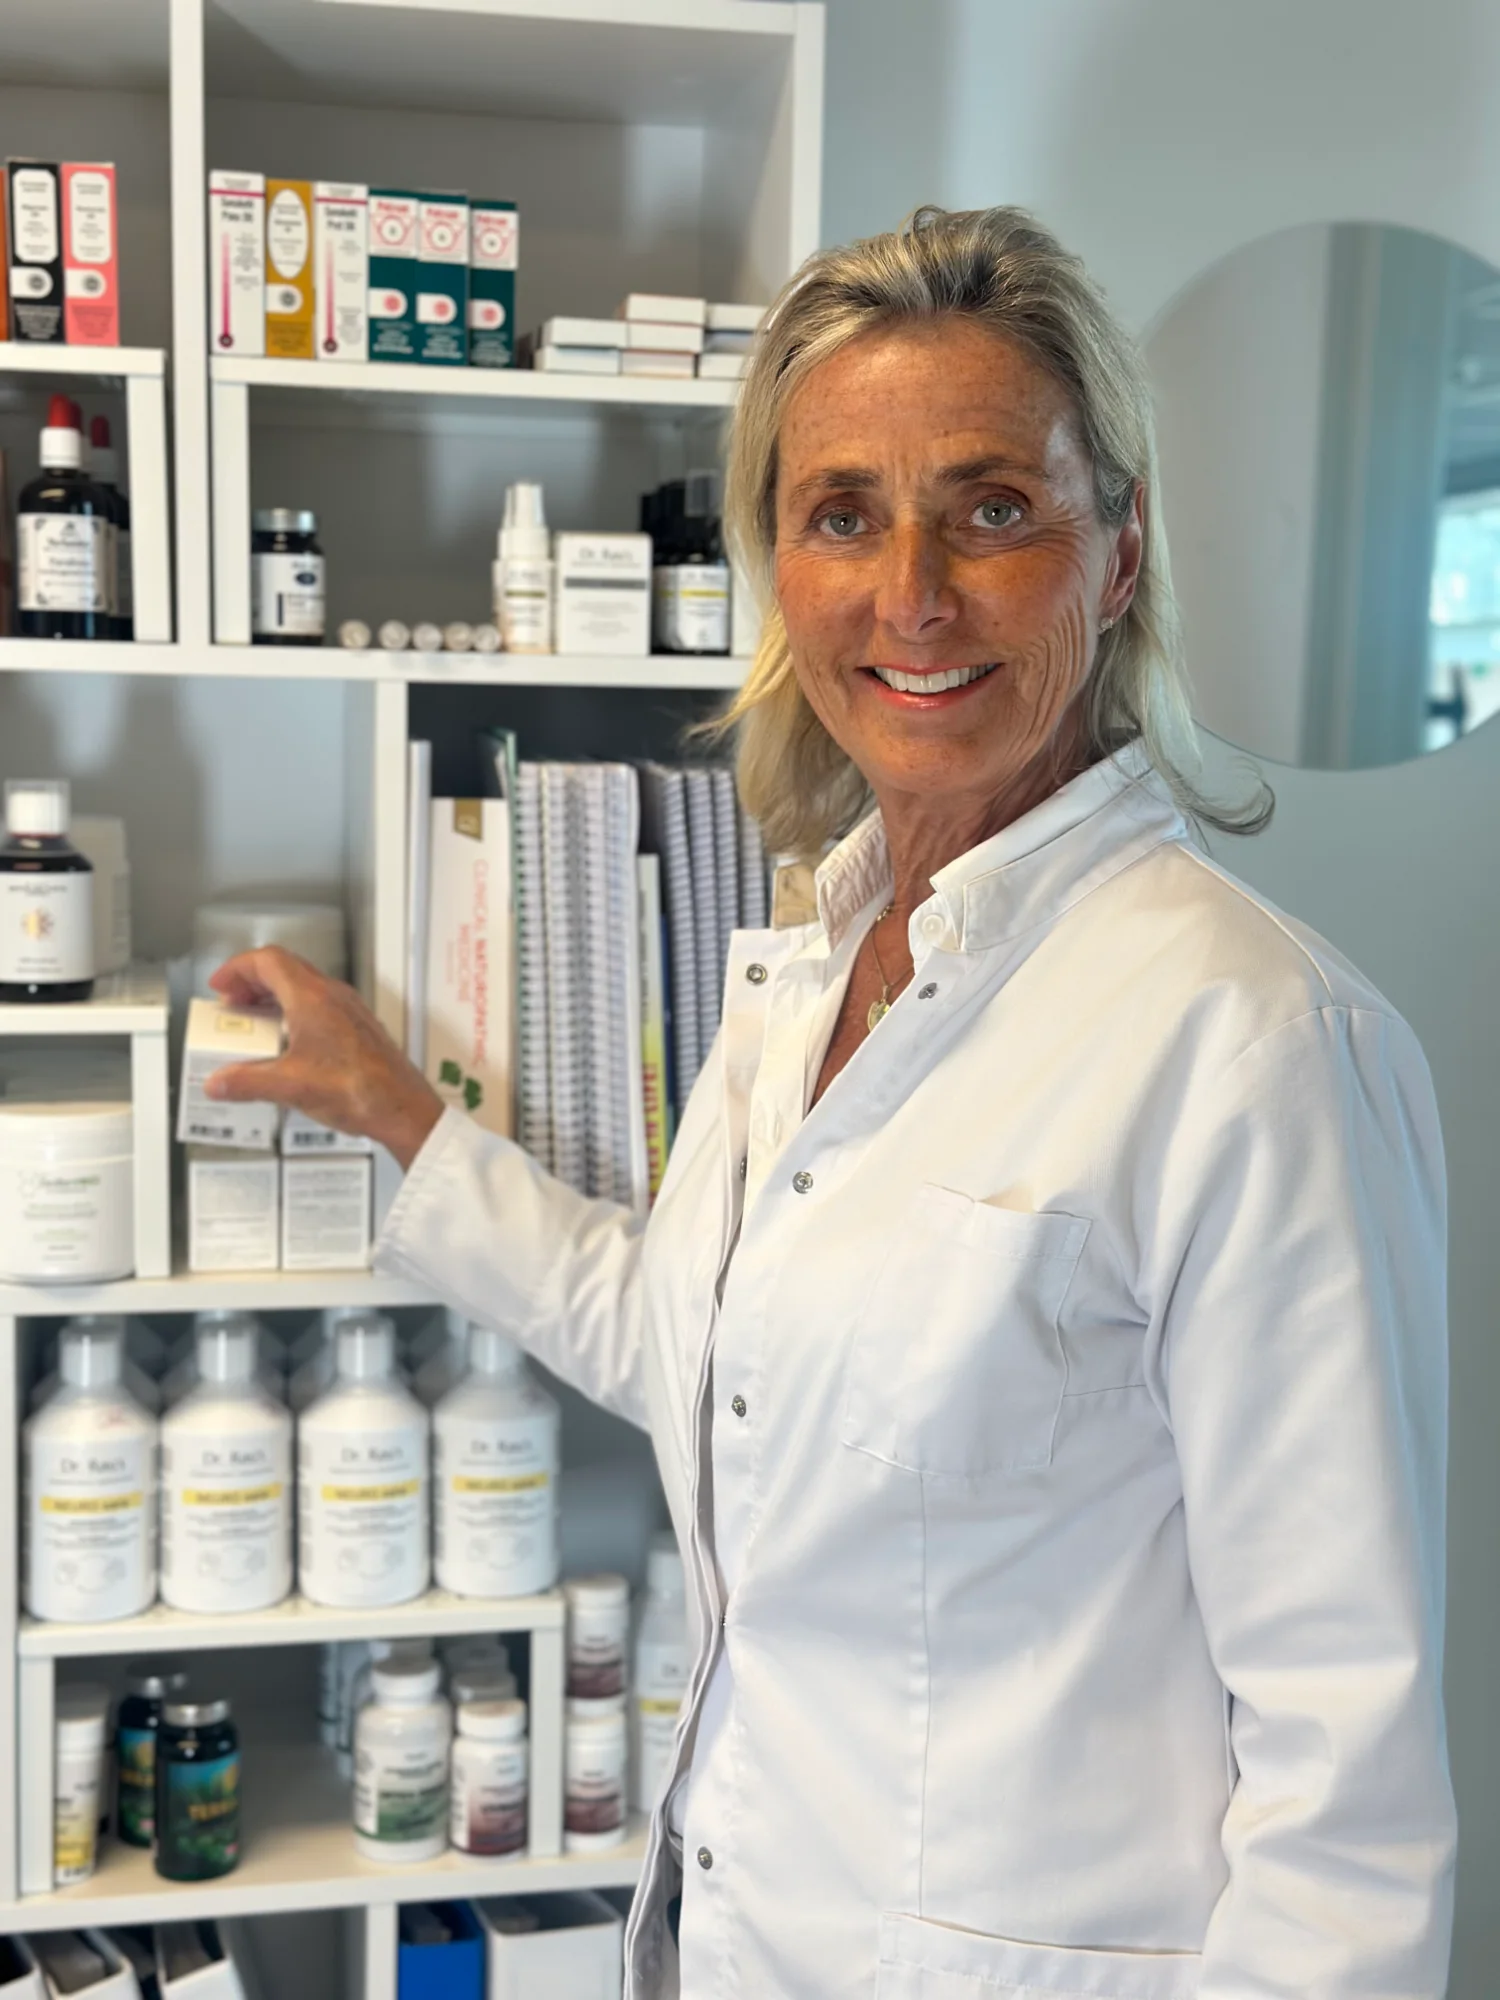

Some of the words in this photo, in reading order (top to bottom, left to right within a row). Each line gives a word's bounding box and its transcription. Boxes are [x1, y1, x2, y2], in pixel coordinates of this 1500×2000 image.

[473, 858, 489, 933] CLINICAL
[457, 924, 471, 1003] MEDICINE
[470, 938, 490, 1068] NATUROPATHIC
